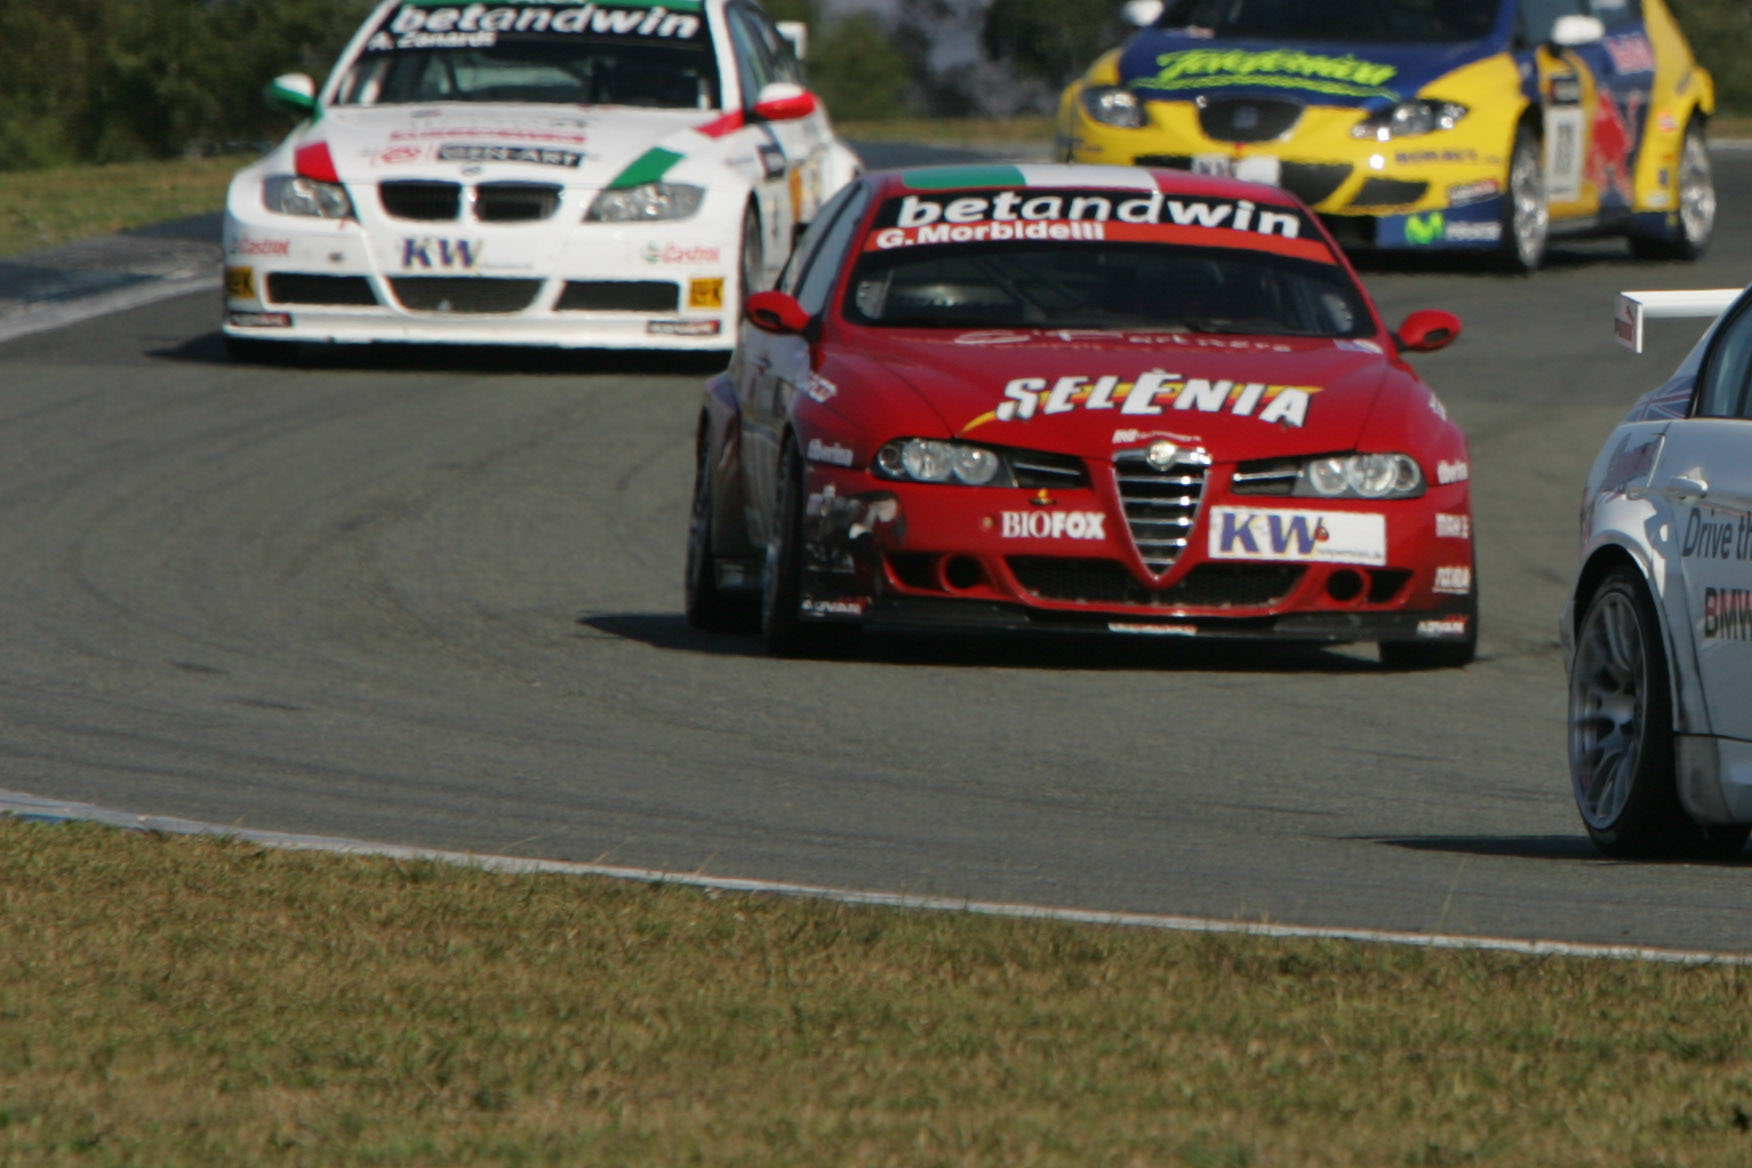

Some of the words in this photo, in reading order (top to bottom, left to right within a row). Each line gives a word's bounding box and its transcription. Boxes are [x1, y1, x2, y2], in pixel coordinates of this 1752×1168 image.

[391, 5, 700, 39] betandwin
[898, 190, 1301, 239] betandwin
[876, 220, 1105, 249] G.Morbidelli
[403, 237, 482, 268] KW
[1001, 510, 1105, 540] BIOFOX
[1219, 513, 1322, 555] KW
[1682, 507, 1733, 559] Drive
